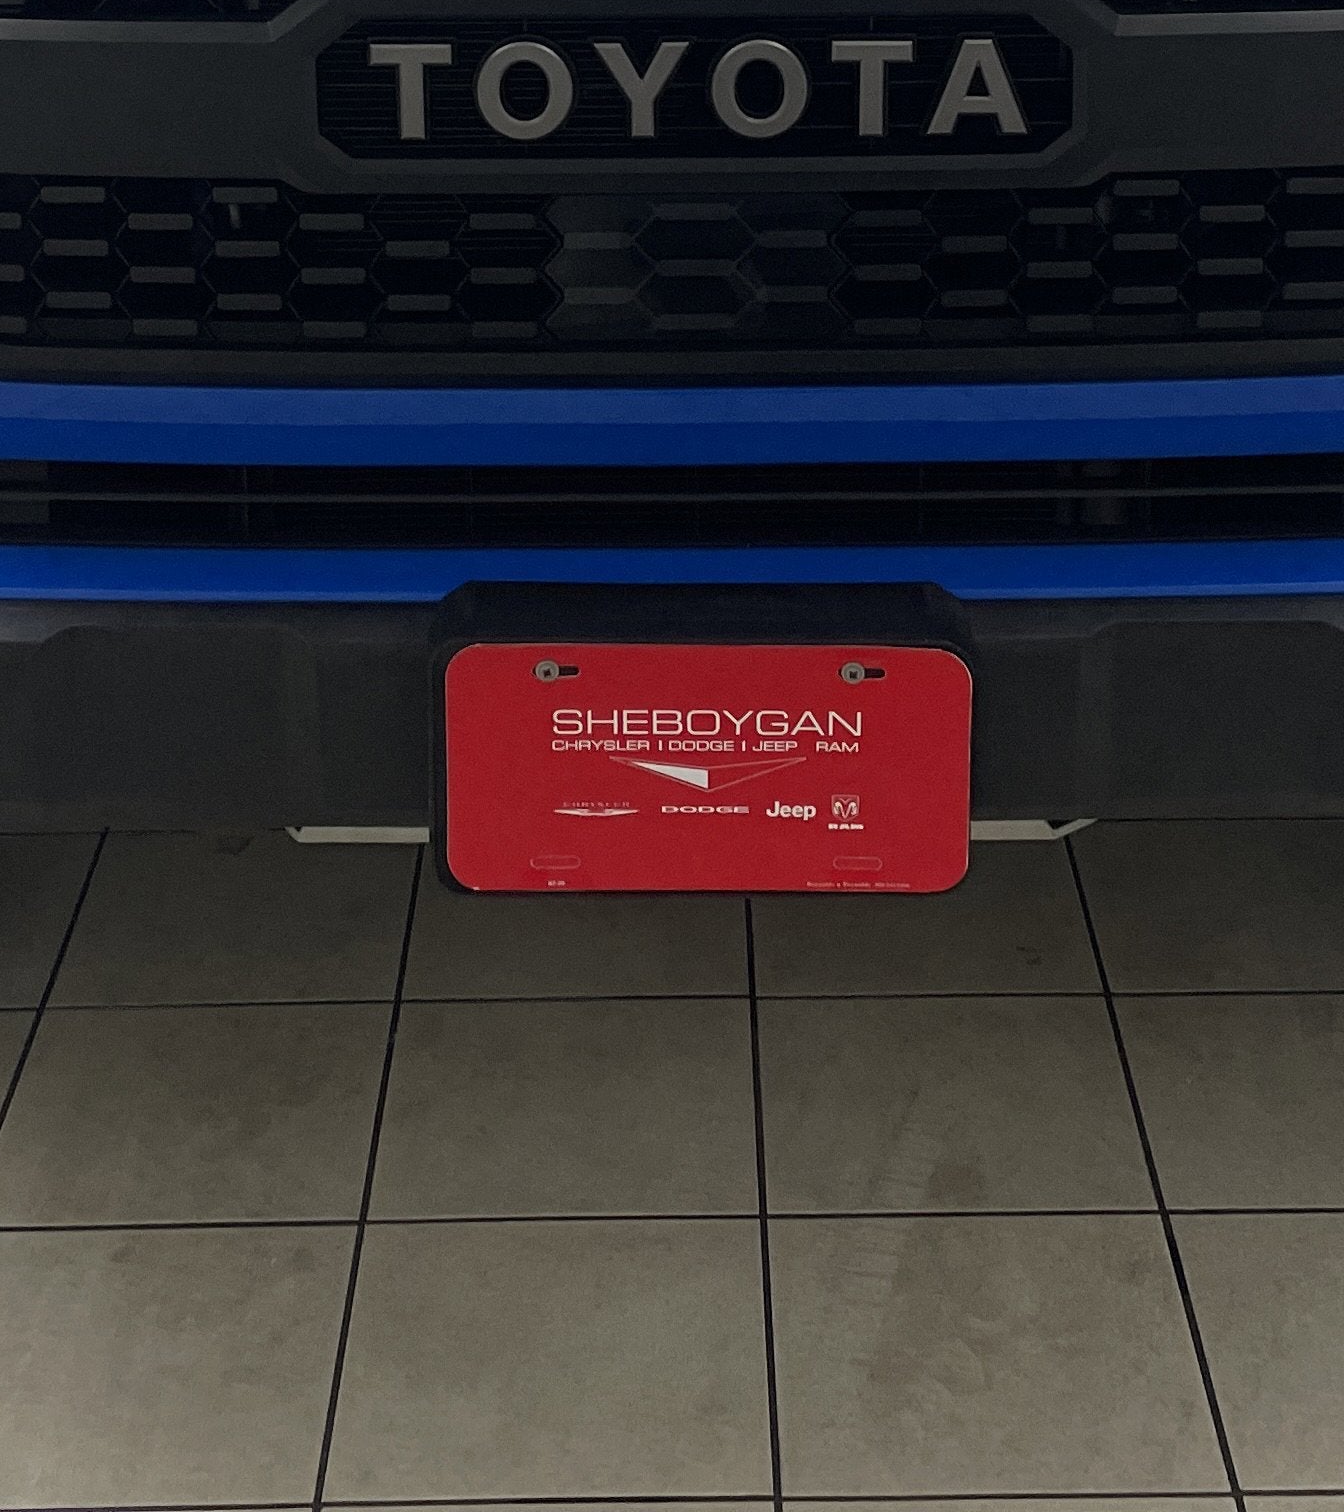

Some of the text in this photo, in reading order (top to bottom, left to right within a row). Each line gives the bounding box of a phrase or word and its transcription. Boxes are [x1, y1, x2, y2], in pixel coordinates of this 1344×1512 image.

[368, 38, 1029, 141] TOYOTA
[552, 709, 862, 737] SHEBOYGAN
[552, 740, 859, 753] CHRYSLER DODGE JEEP RAM
[661, 805, 750, 814] DODGE
[765, 800, 817, 821] Jeep
